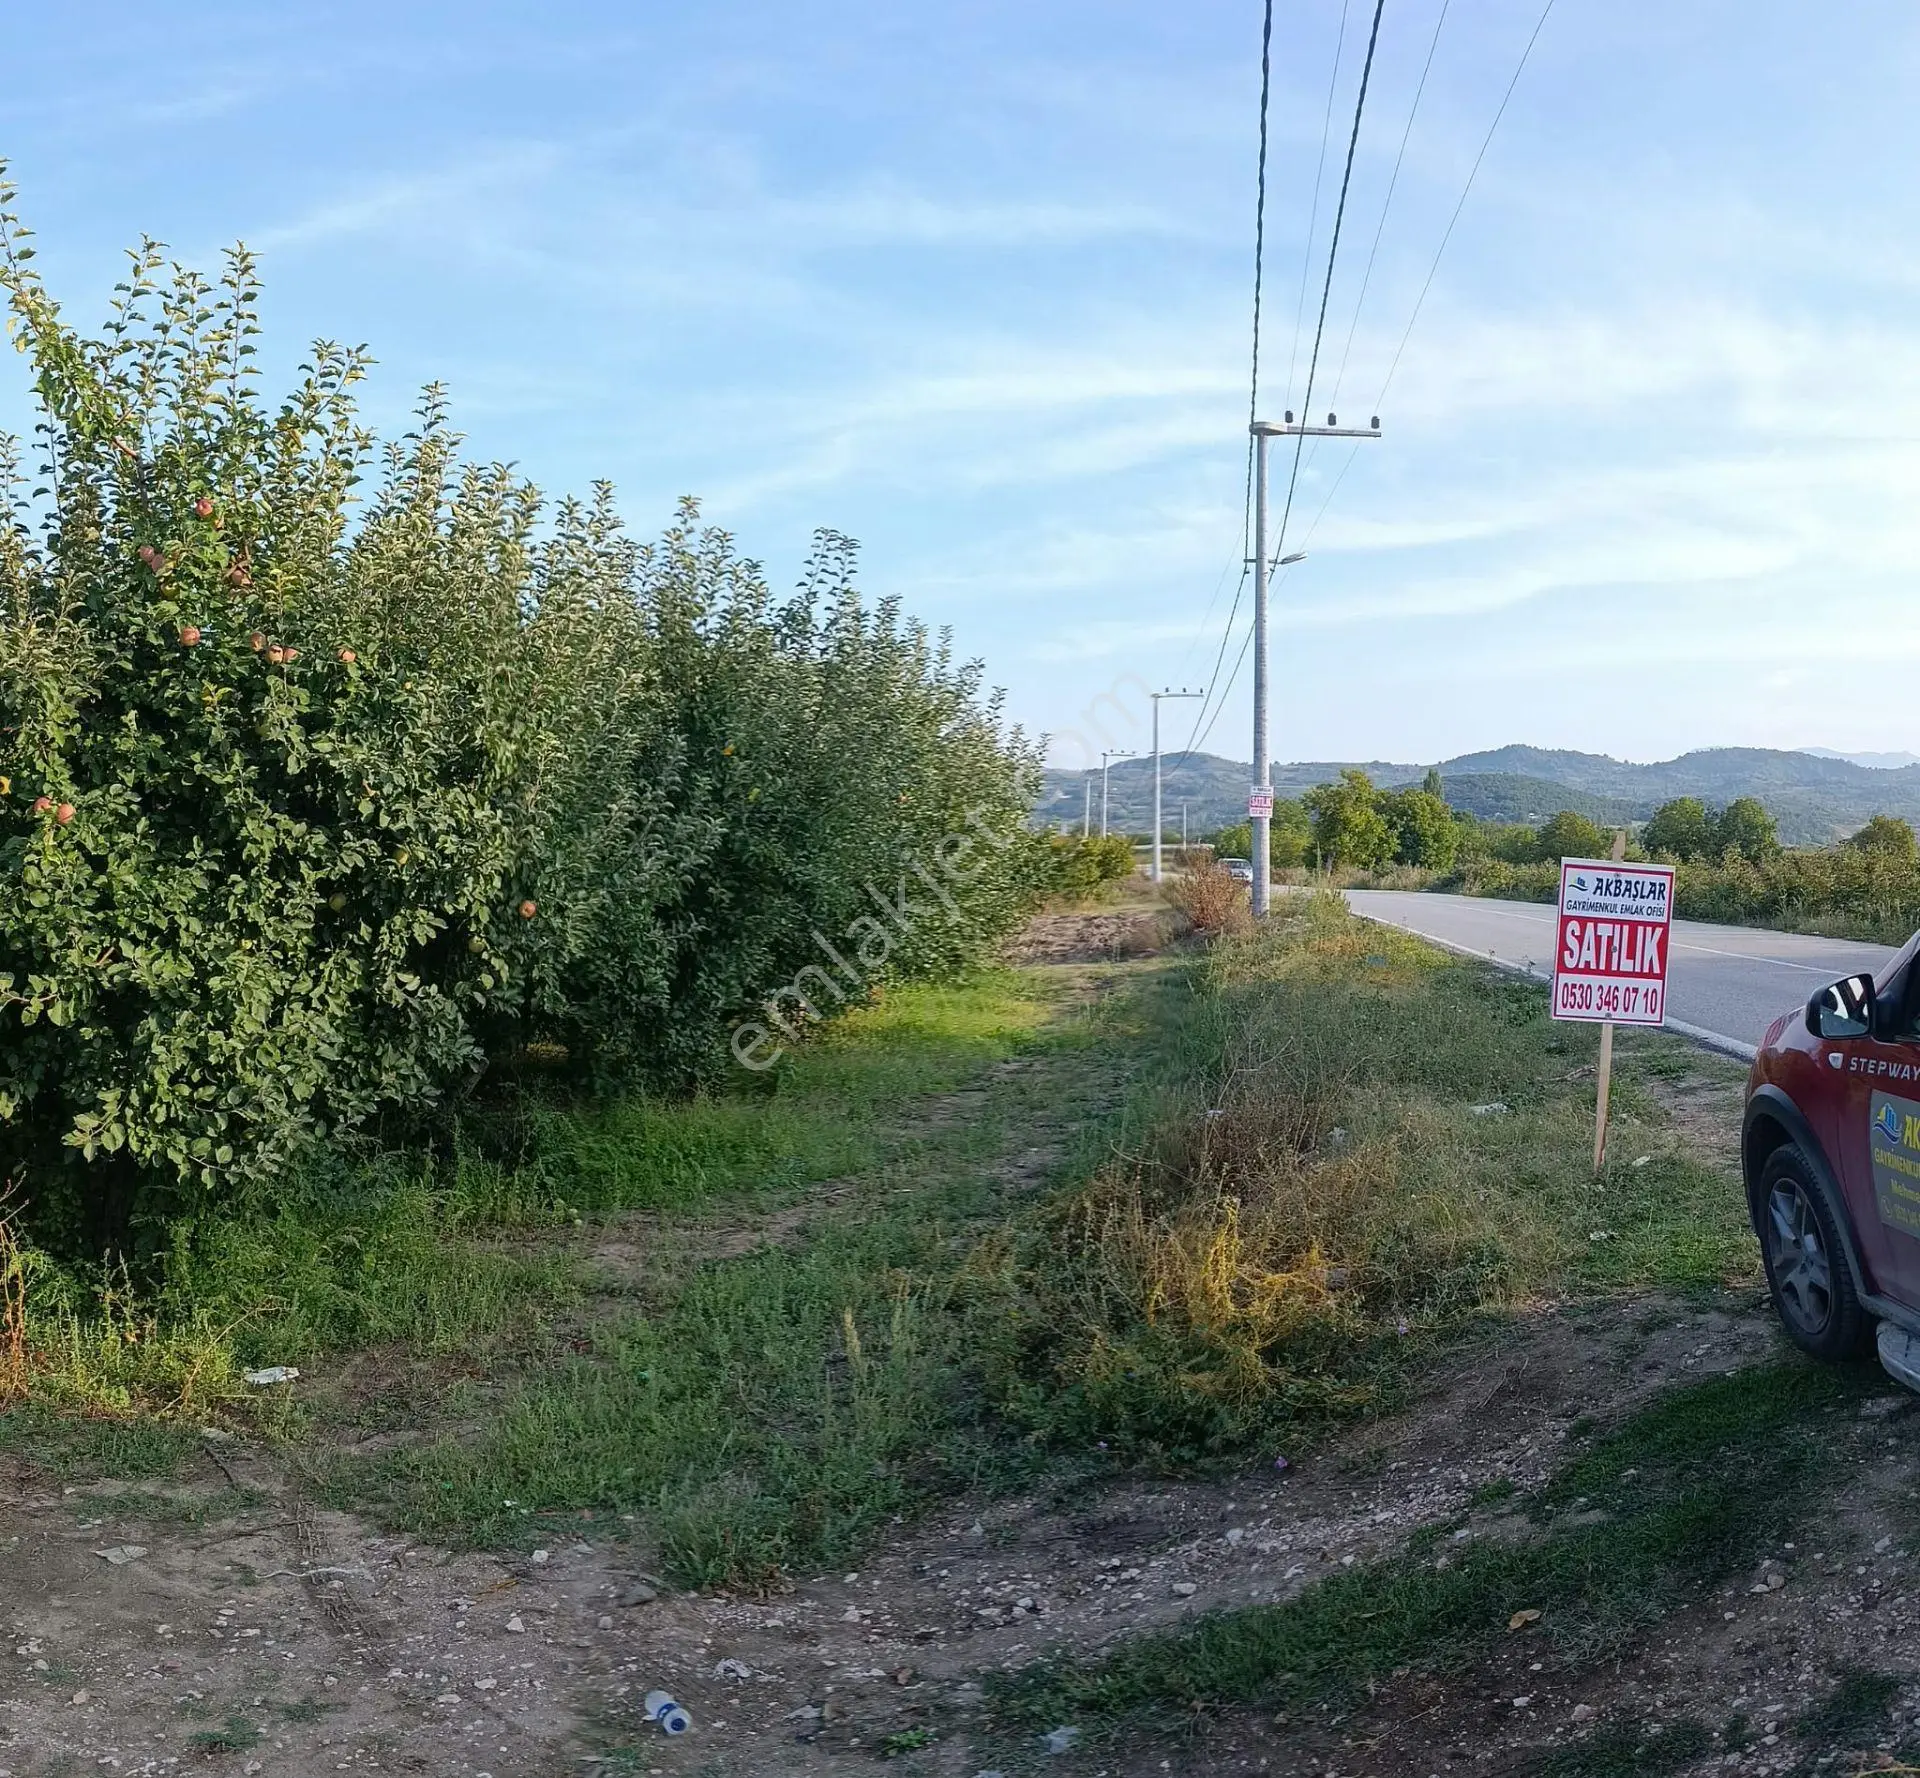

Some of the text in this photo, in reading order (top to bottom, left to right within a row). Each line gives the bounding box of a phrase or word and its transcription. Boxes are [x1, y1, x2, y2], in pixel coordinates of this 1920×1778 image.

[1592, 877, 1666, 901] AKBAŞLAR
[1566, 898, 1666, 917] GAYRİMENKUL EMLAK OFİSİ
[1563, 920, 1664, 974] SATILIK
[1561, 982, 1658, 1015] 0530 346 07 10
[1849, 1056, 1920, 1081] STEPWAY
[1903, 1113, 1920, 1150] AK
[1874, 1148, 1920, 1178] GAYRİMENKU
